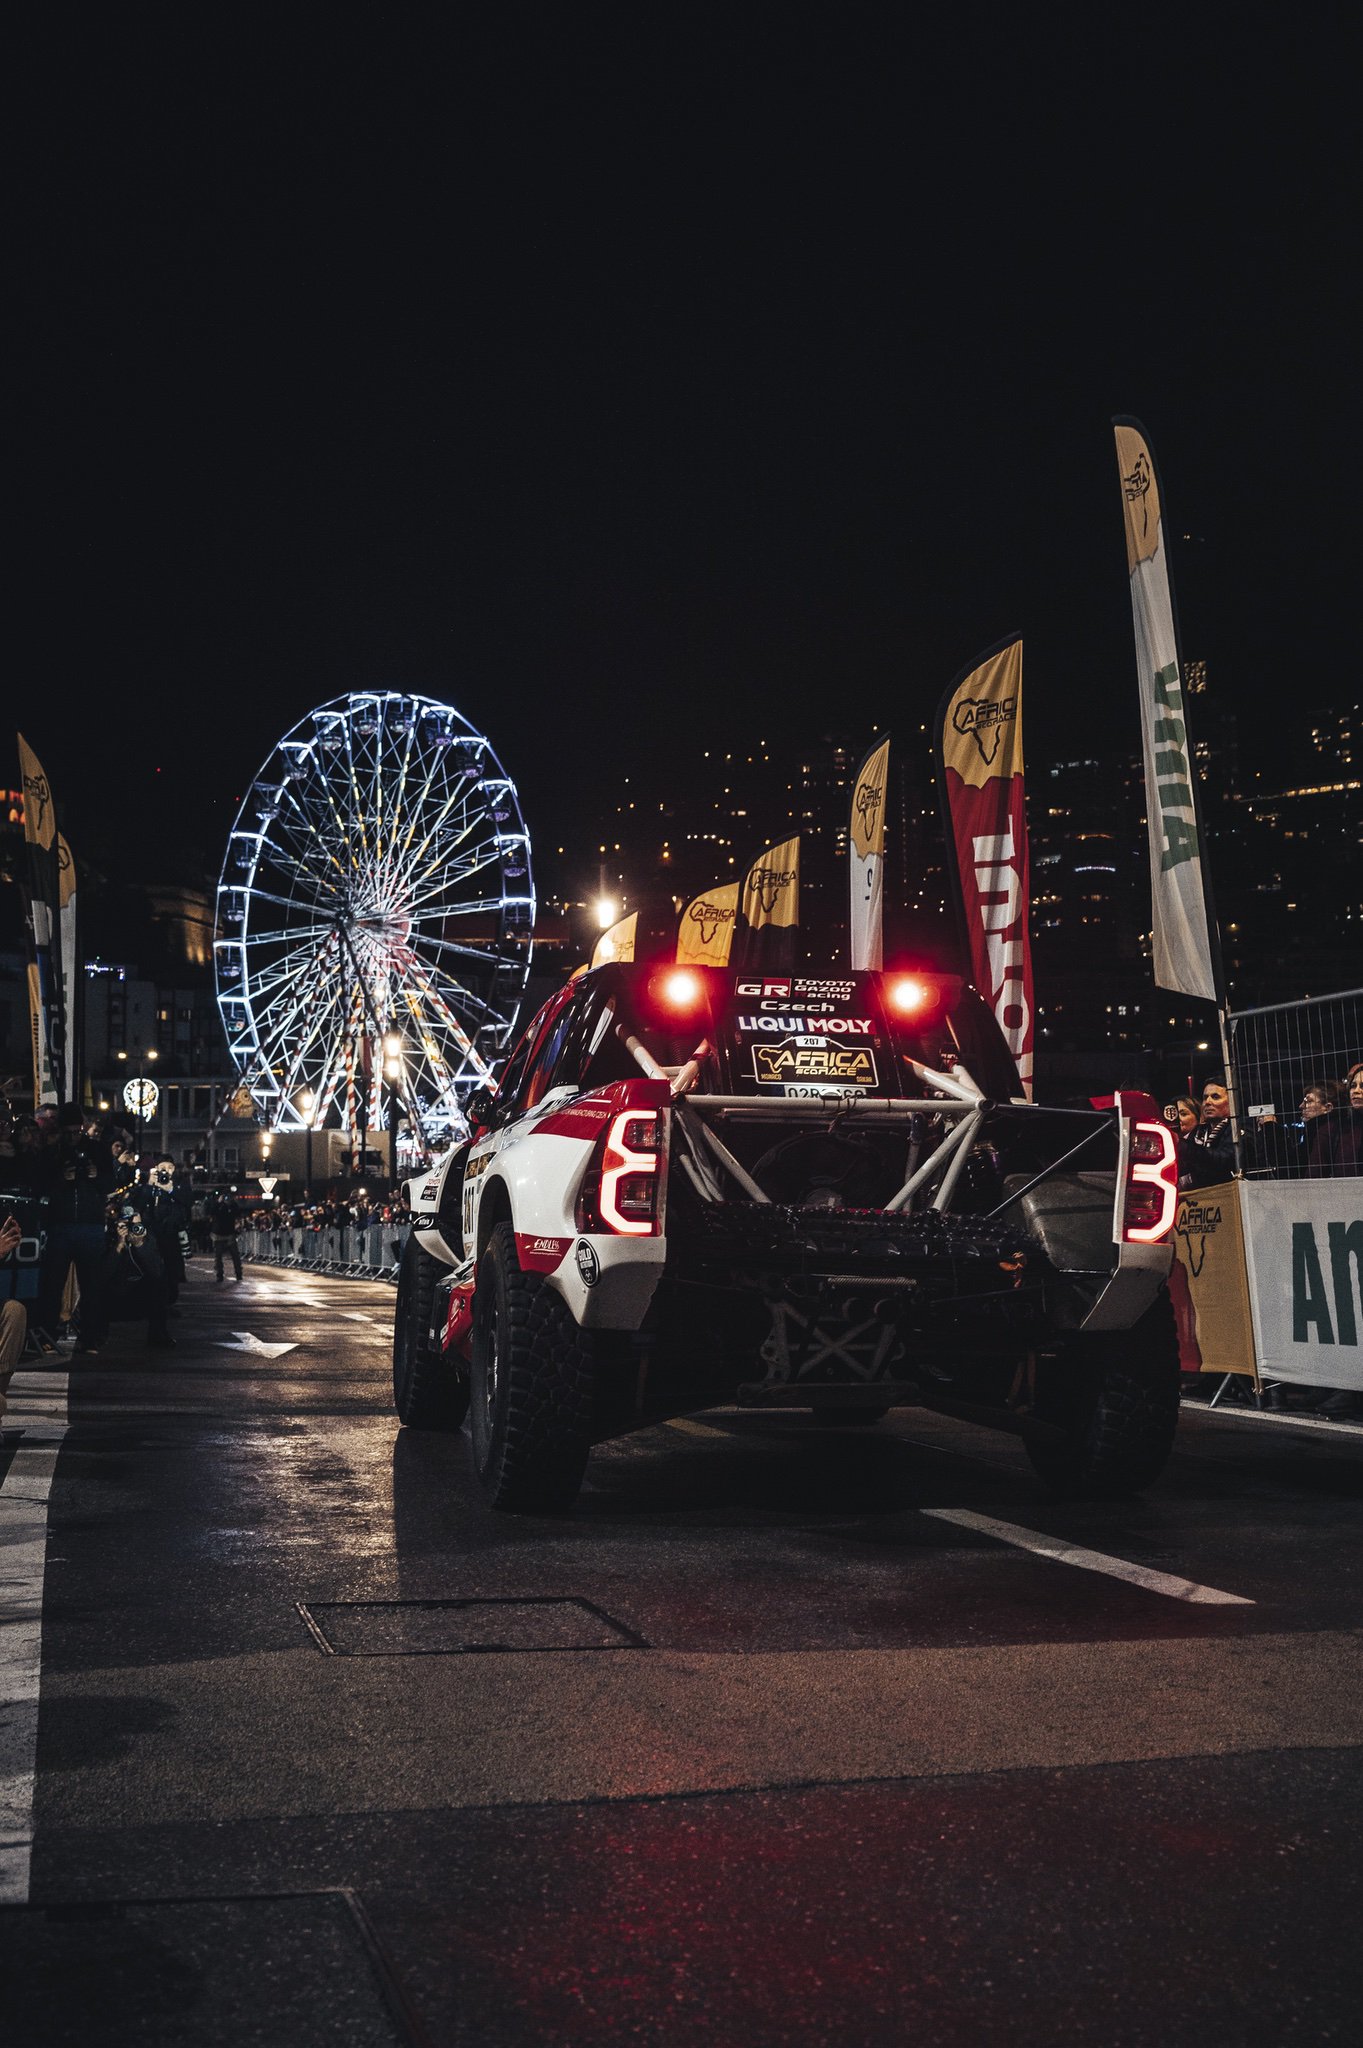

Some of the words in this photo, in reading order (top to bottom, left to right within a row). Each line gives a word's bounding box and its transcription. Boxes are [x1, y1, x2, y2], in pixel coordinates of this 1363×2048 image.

[694, 908, 735, 918] AFRICA
[794, 978, 856, 987] TOYOTA
[737, 984, 789, 997] GR
[794, 985, 852, 993] GAZOO
[760, 1000, 835, 1012] Czech
[738, 1016, 804, 1032] LIQUI
[807, 1018, 872, 1033] MOLY
[803, 1037, 819, 1046] 207
[774, 1050, 870, 1069] AFRICA
[1178, 1206, 1222, 1228] AFRICA
